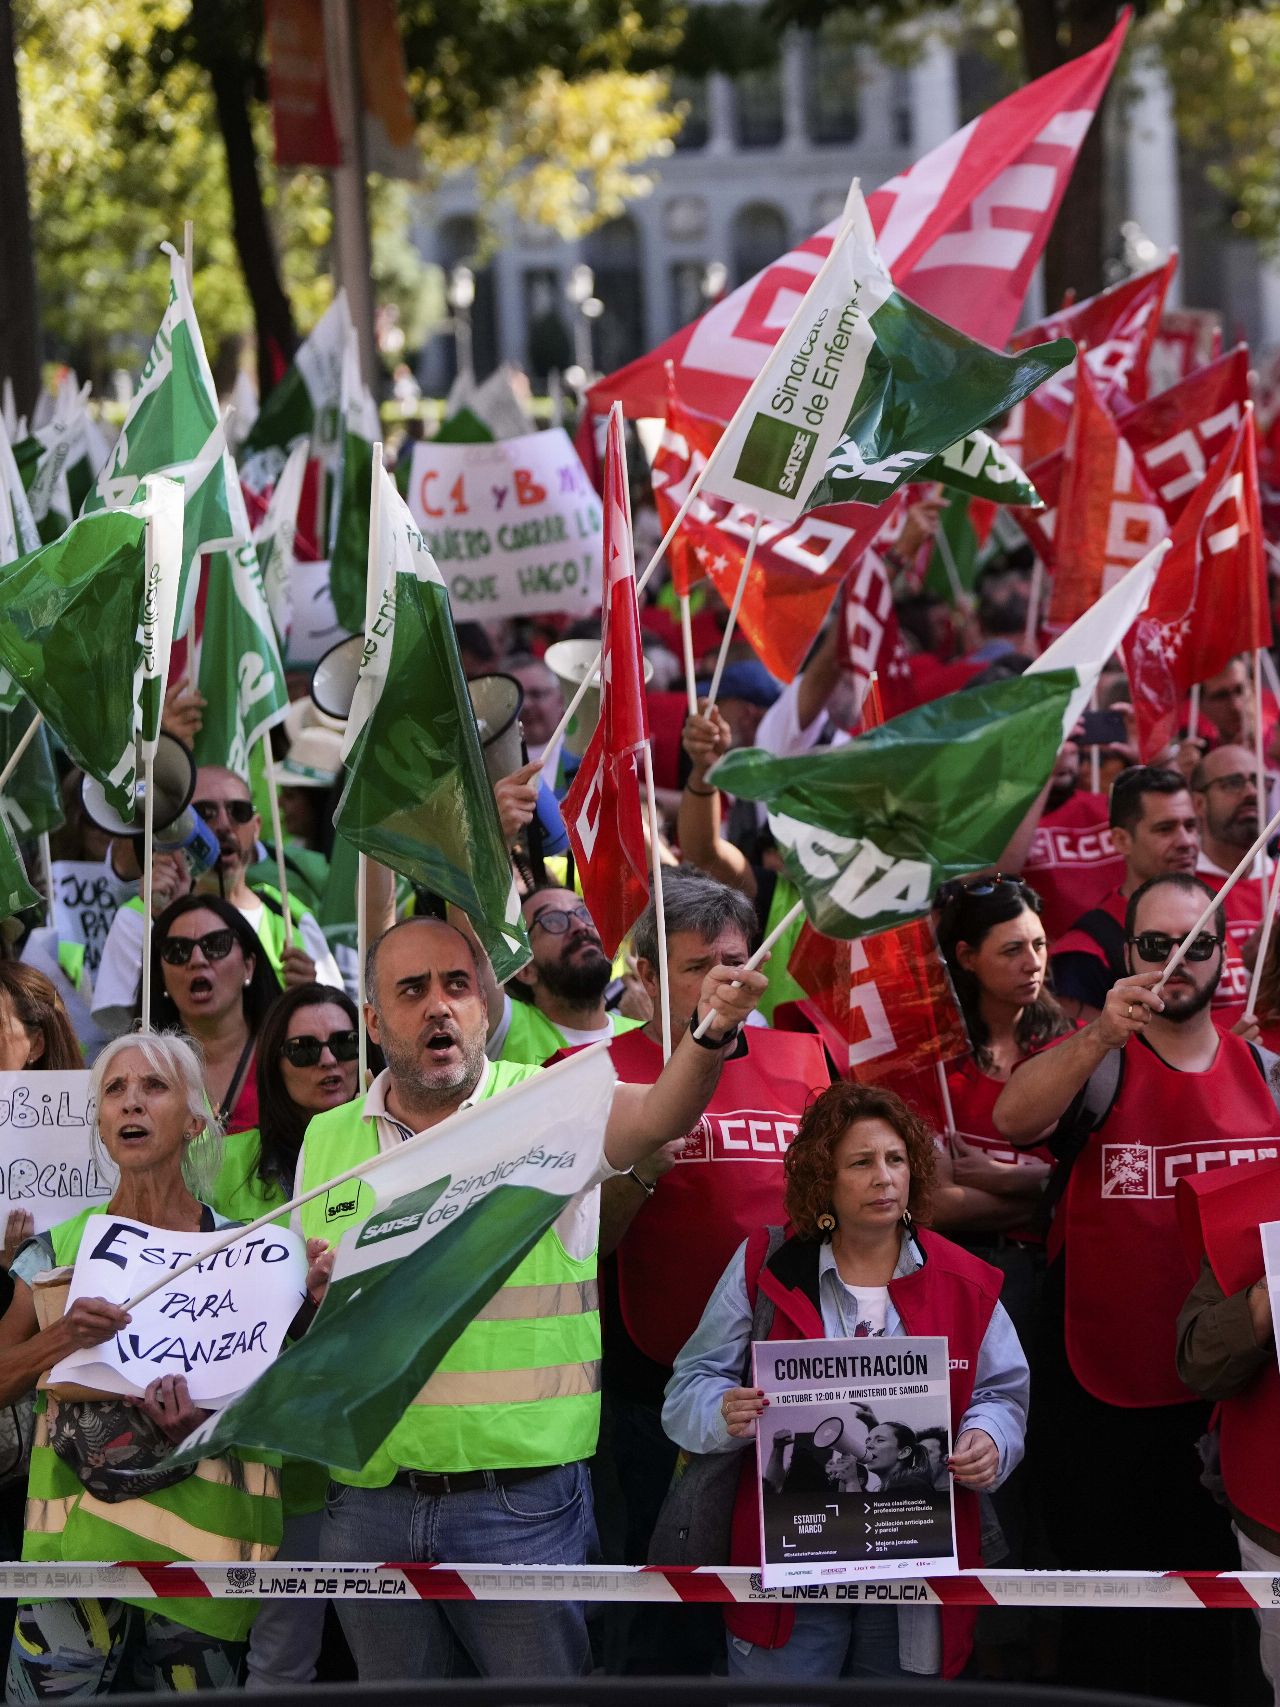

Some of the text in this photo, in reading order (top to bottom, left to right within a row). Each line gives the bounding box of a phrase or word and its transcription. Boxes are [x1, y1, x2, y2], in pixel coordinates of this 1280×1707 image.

[802, 389, 829, 426] de
[778, 430, 811, 494] SATSE
[420, 470, 469, 518] C1
[514, 469, 547, 507] B
[361, 1202, 459, 1240] SATSE de
[159, 1288, 239, 1323] PARA
[774, 1350, 928, 1381] CONCENTRACIÓN
[782, 1393, 813, 1404] OCTUBRE
[815, 1392, 834, 1401] 12:00
[835, 1392, 841, 1400] H
[848, 1388, 887, 1399] MINISTERIO
[889, 1386, 898, 1396] DE
[899, 1384, 929, 1395] SANIDAD
[793, 1513, 827, 1525] ESTATUTO
[798, 1524, 823, 1534] MARCO
[259, 1579, 407, 1596] LINEA DE POLICIA
[781, 1584, 928, 1601] LINEA DE POLICIA
